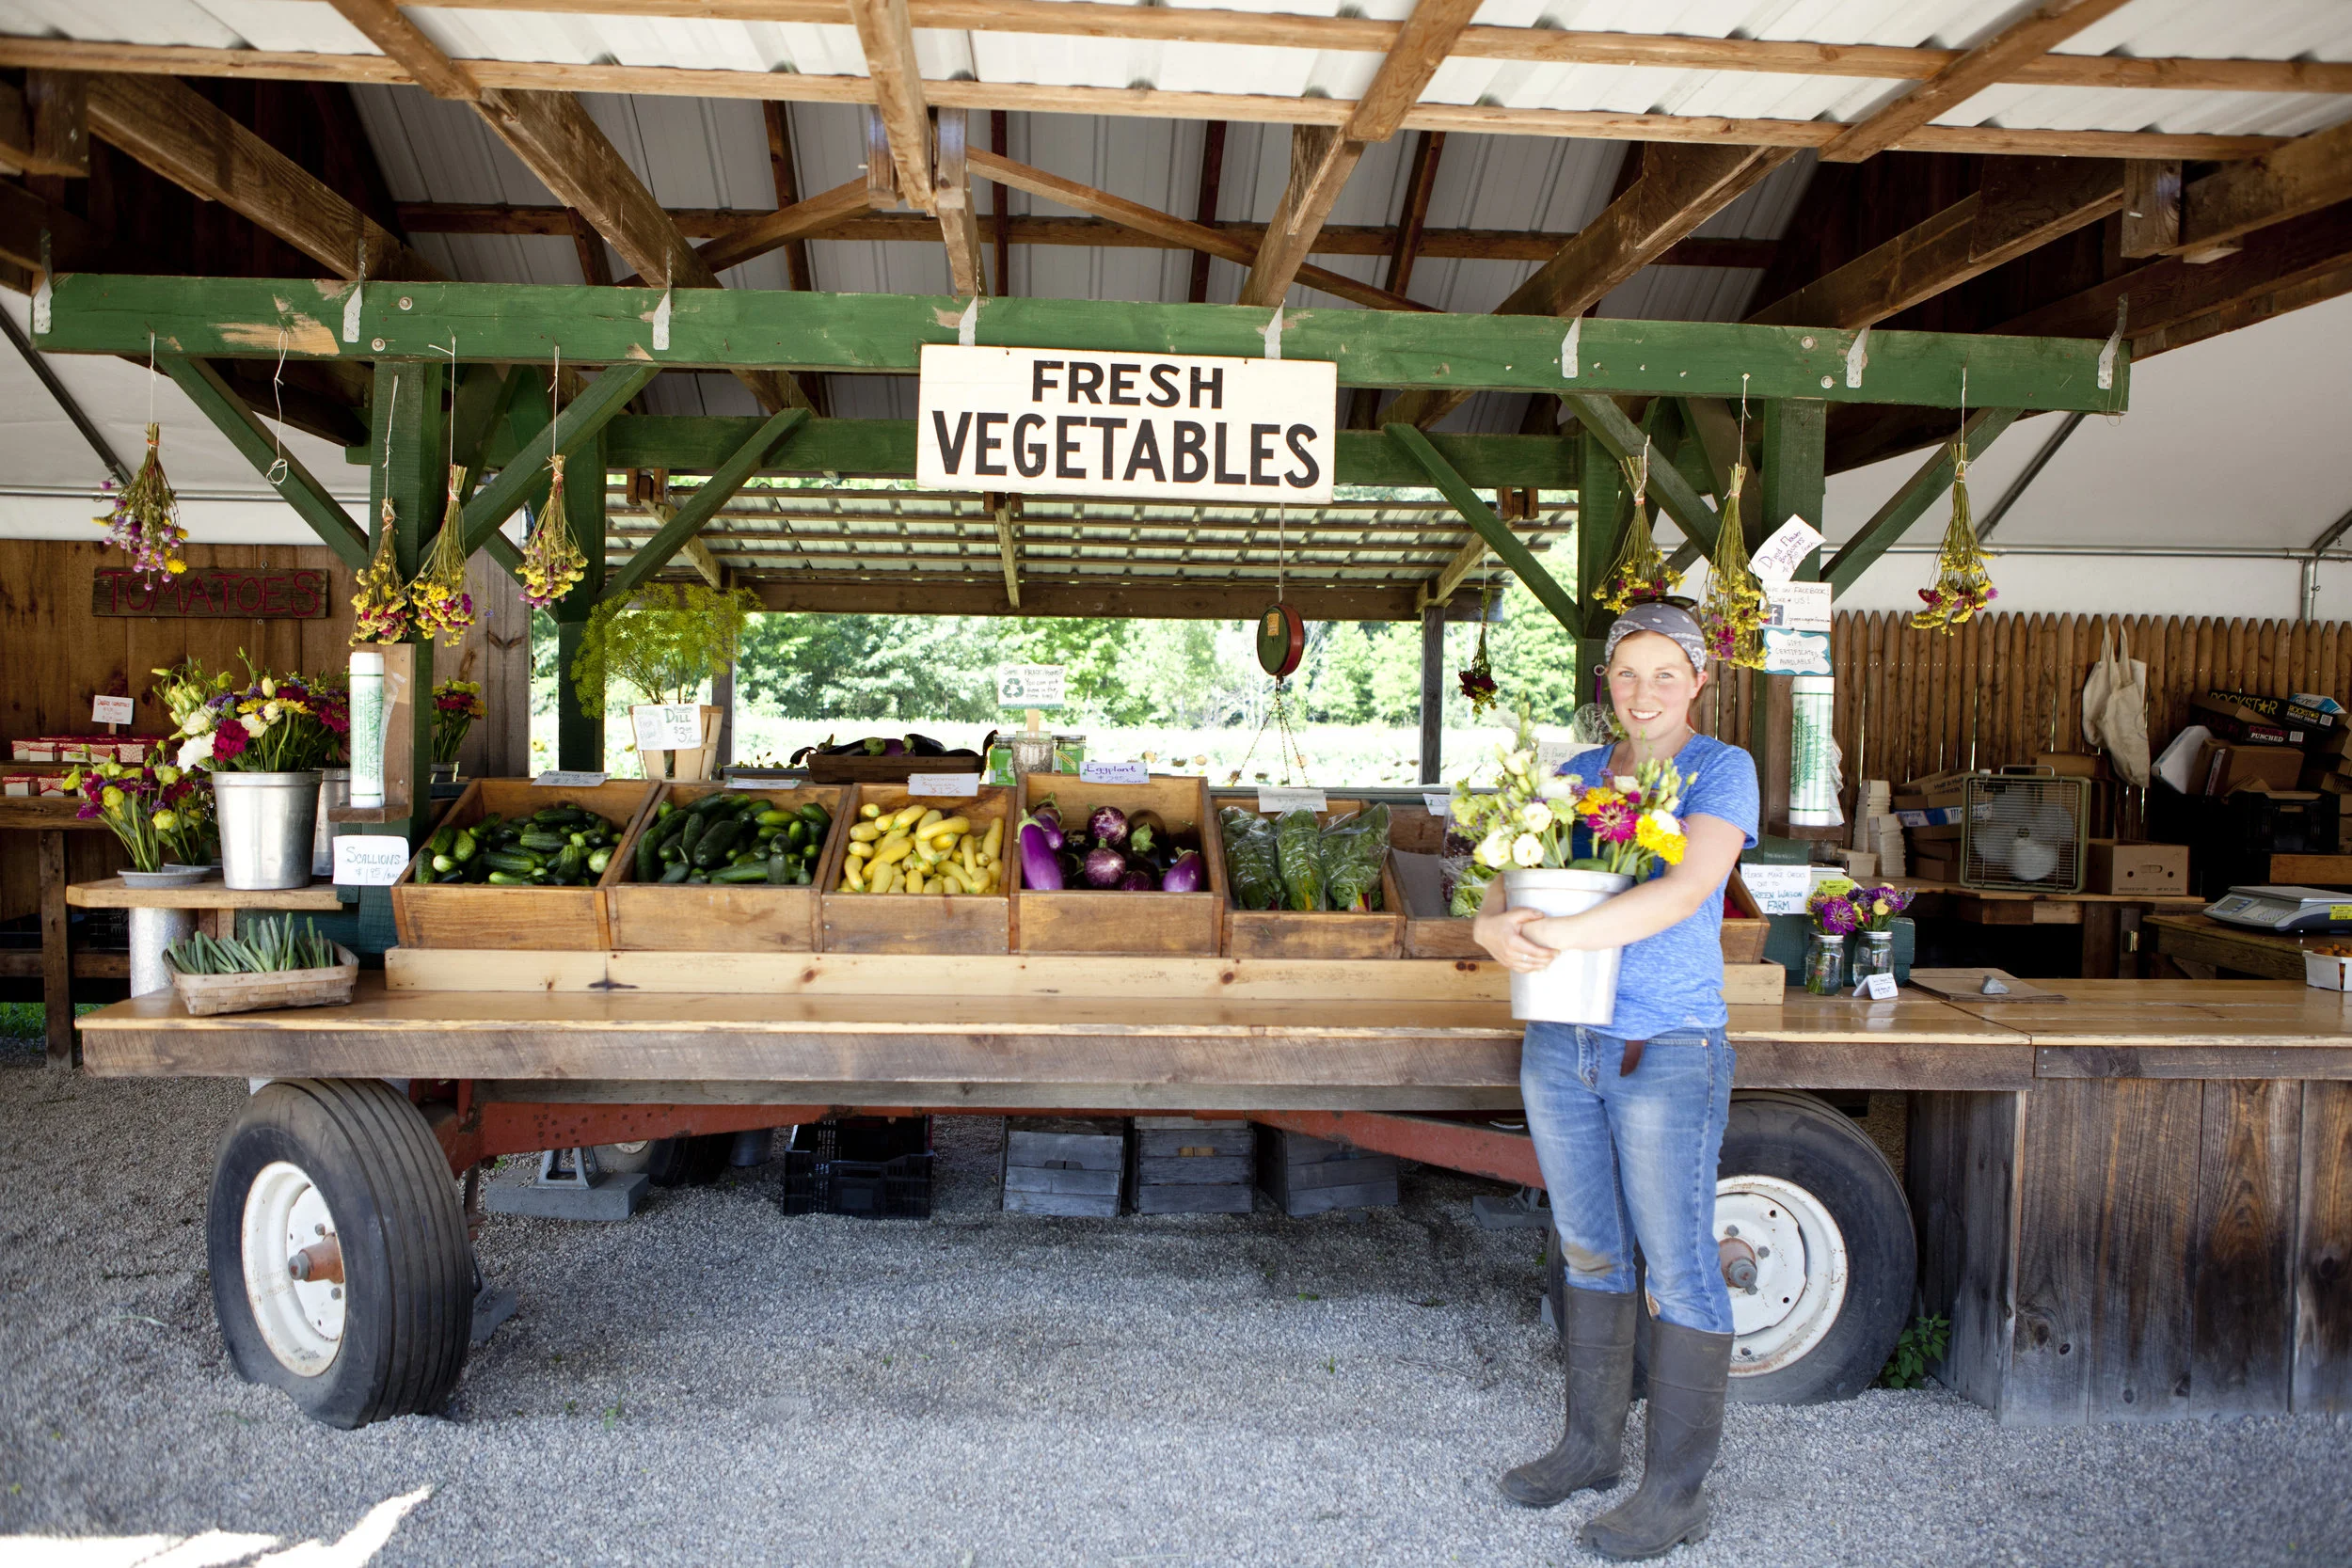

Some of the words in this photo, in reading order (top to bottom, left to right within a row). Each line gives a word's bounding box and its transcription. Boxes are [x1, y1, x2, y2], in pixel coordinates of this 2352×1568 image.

[1032, 359, 1224, 410] FRESH
[931, 409, 1320, 489] VEGETABLES
[99, 570, 320, 617] TOMATOES
[663, 707, 691, 723] DILL
[2250, 732, 2284, 743] PUNCHED
[1087, 764, 1136, 775] Eggplant
[345, 846, 402, 865] SCALLIONS
[1777, 889, 1804, 899] WAGON
[1766, 899, 1790, 911] FARM
